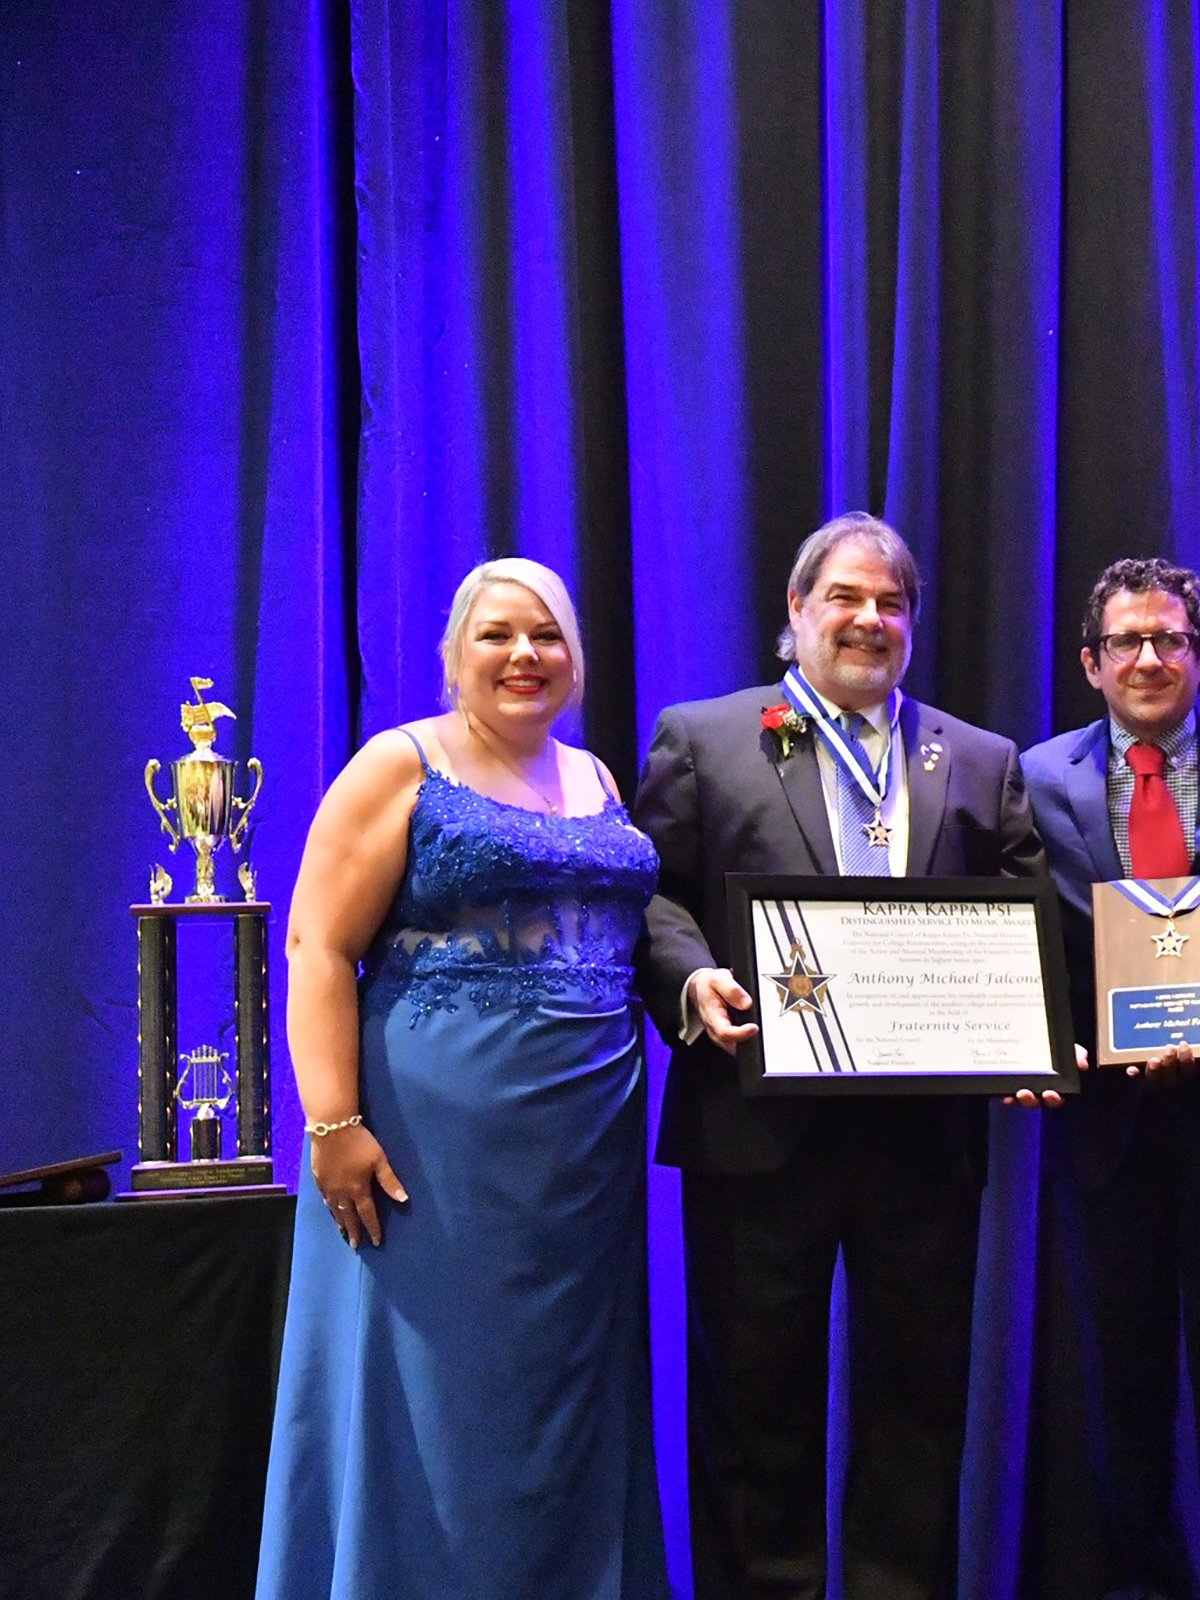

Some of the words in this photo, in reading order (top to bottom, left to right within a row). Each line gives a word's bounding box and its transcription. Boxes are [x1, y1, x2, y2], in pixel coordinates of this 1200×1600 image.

[863, 902, 918, 916] KAPPA
[925, 903, 980, 916] KAPPA
[986, 903, 1011, 916] PSI
[841, 916, 915, 925] DISTINGUISHED
[918, 917, 952, 926] SERVICE
[955, 918, 969, 926] TO
[971, 918, 1000, 926] MUSIC
[847, 971, 915, 988] Anthony
[919, 971, 981, 984] Michael
[984, 971, 1041, 986] Falcone
[889, 1020, 960, 1034] Fraternity
[964, 1020, 1011, 1031] Service
